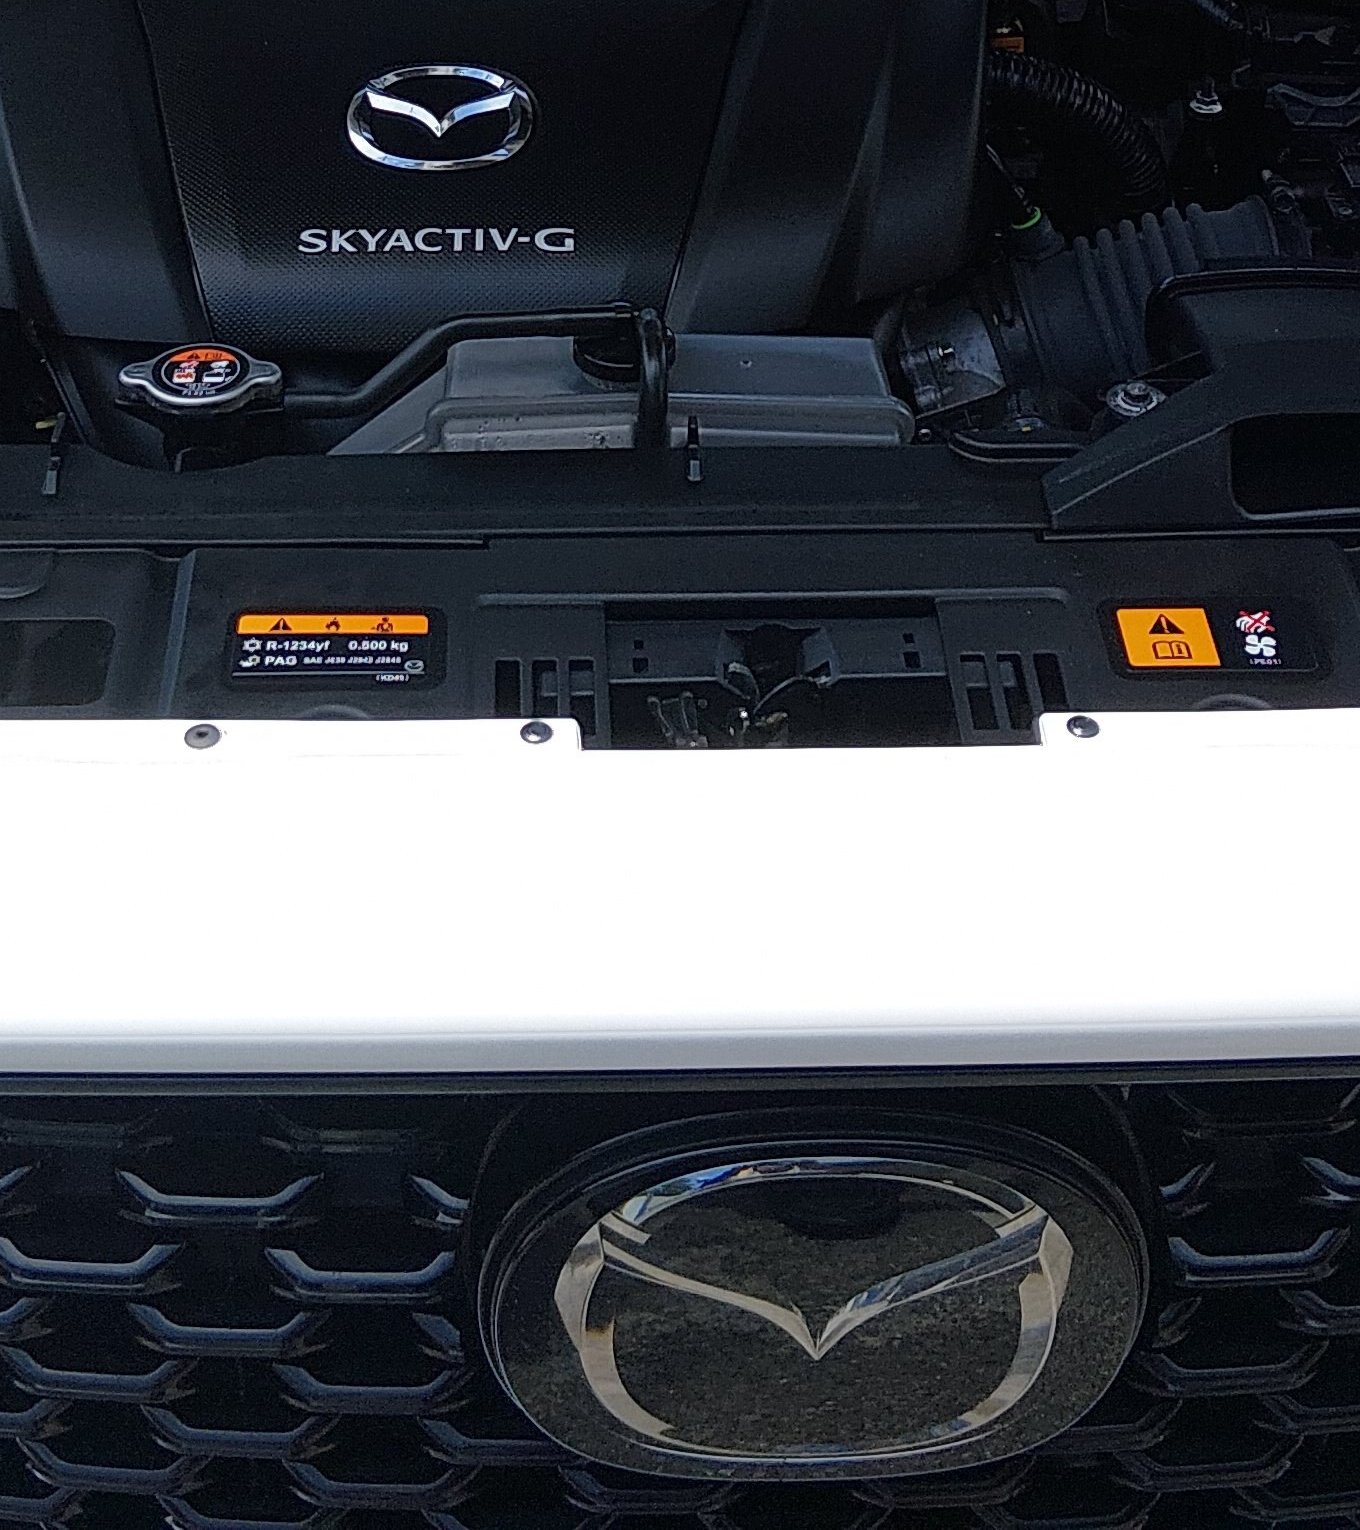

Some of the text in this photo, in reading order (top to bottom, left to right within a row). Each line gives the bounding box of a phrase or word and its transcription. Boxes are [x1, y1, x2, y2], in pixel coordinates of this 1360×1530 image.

[297, 227, 575, 253] SKYACTIV-G
[265, 640, 409, 652] R-1234yf 0.500 kg
[264, 655, 297, 666] PAG
